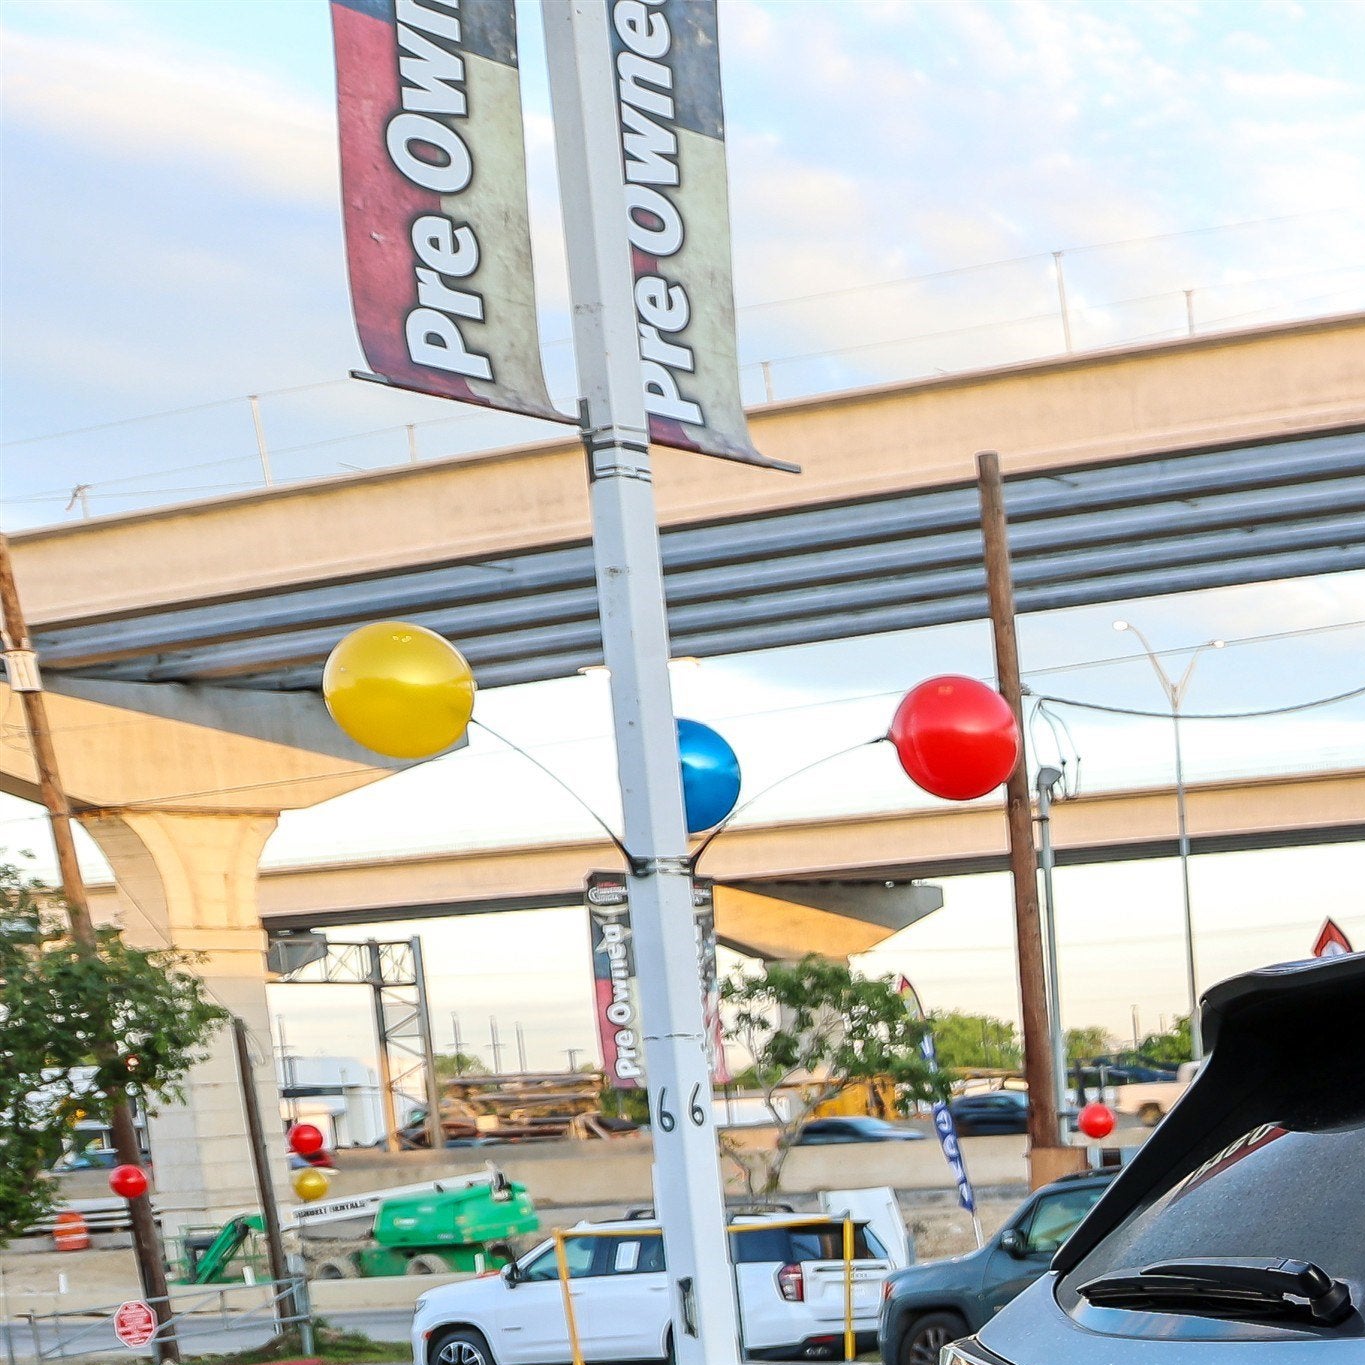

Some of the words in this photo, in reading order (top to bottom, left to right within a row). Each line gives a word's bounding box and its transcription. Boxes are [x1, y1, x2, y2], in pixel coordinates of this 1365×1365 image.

[612, 0, 684, 256] Owne
[405, 214, 493, 381] Pre
[634, 276, 705, 426] Pre
[602, 923, 634, 1025] Owned
[615, 1028, 641, 1080] Pre
